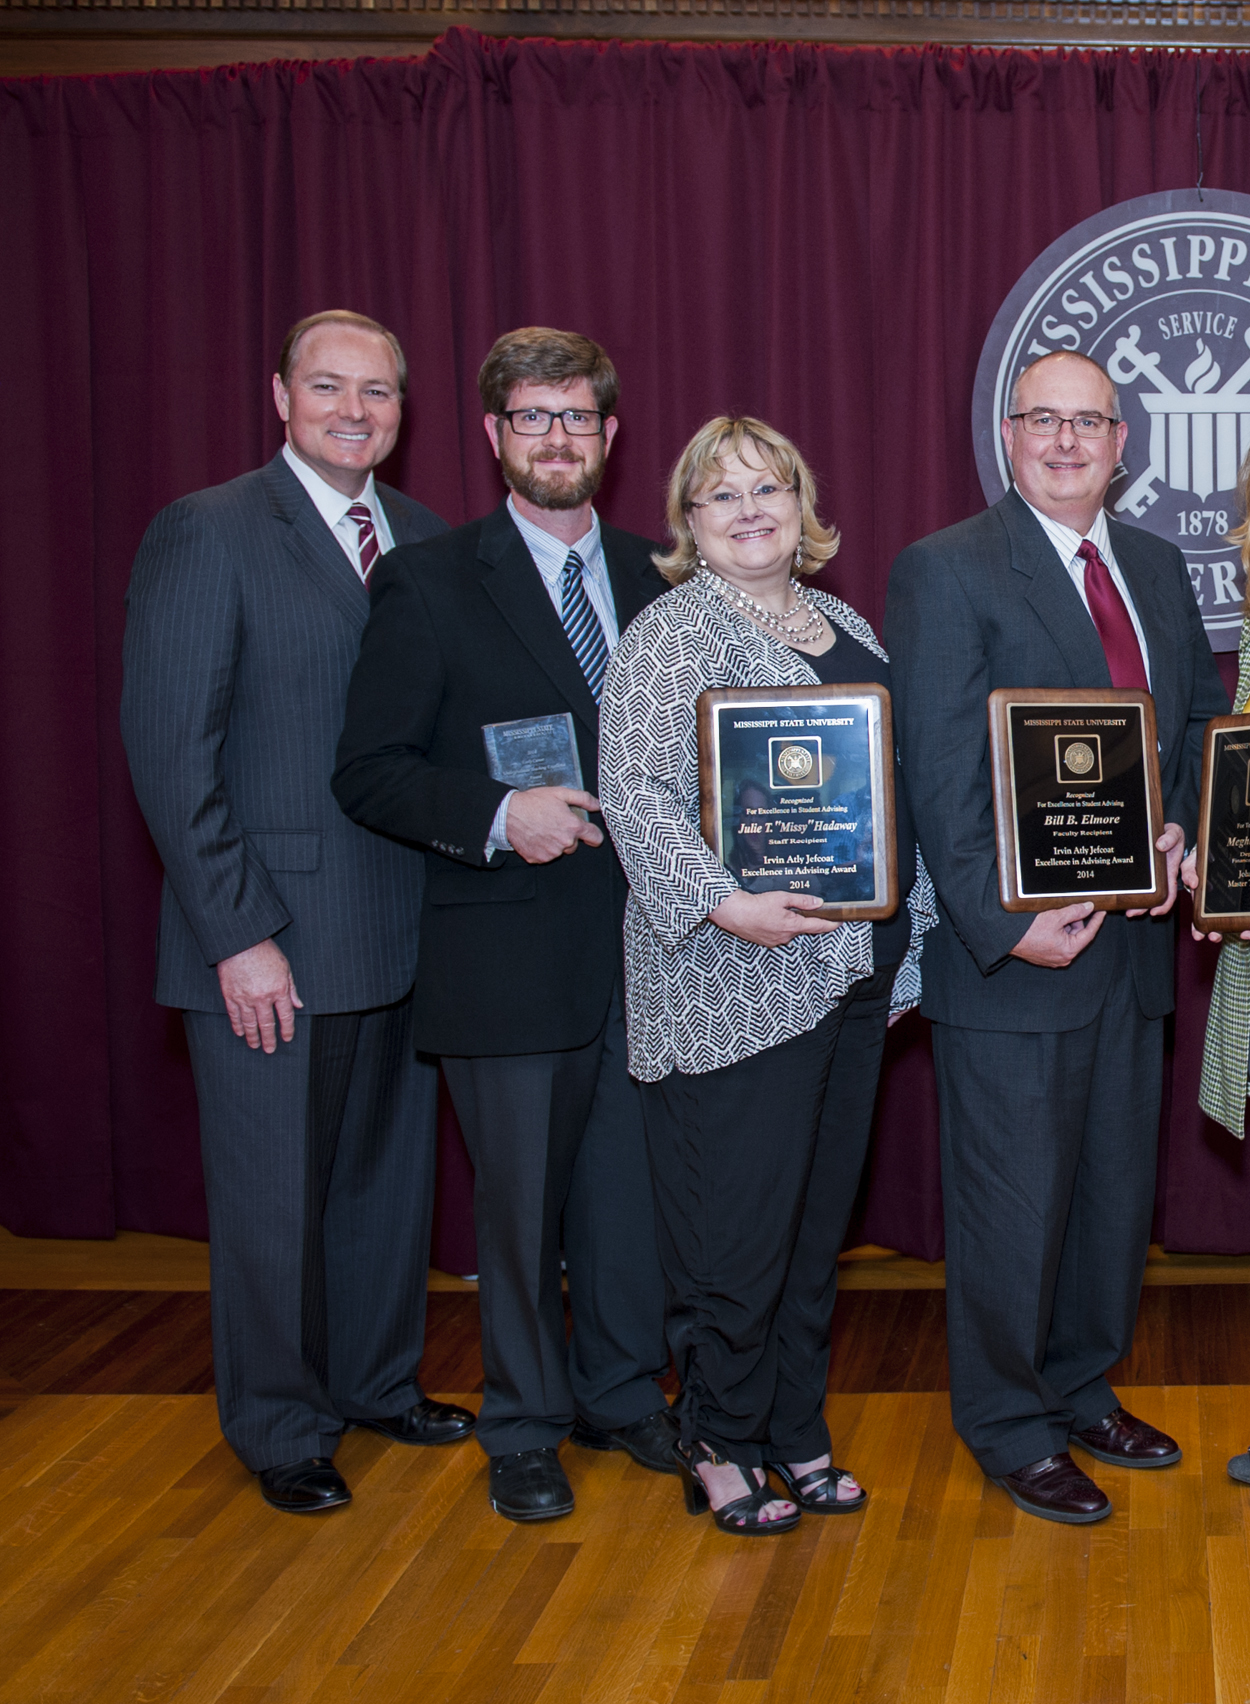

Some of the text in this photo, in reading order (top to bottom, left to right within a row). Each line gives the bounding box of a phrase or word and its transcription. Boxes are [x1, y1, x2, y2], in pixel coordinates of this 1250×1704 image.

[1158, 311, 1238, 341] SERVICE
[1177, 510, 1229, 537] 1878
[734, 718, 855, 729] MISSISSIPPI STATE UNIVERSITY
[780, 797, 814, 805] Recognized
[821, 805, 848, 813] Advising
[1044, 815, 1120, 826] Bill B. Elmore
[738, 819, 858, 834] Julie T. "Missy" Hadaway
[1053, 846, 1115, 855] Irvin Atly Jefcoat
[763, 854, 834, 864] Irvin Atly Jefcoat
[1035, 856, 1134, 867] Excellence in Advising Award
[741, 865, 857, 877] Excellence in Advising Award
[1077, 871, 1095, 879] 2014
[790, 881, 810, 890] 2014
[1228, 880, 1248, 888] Master
